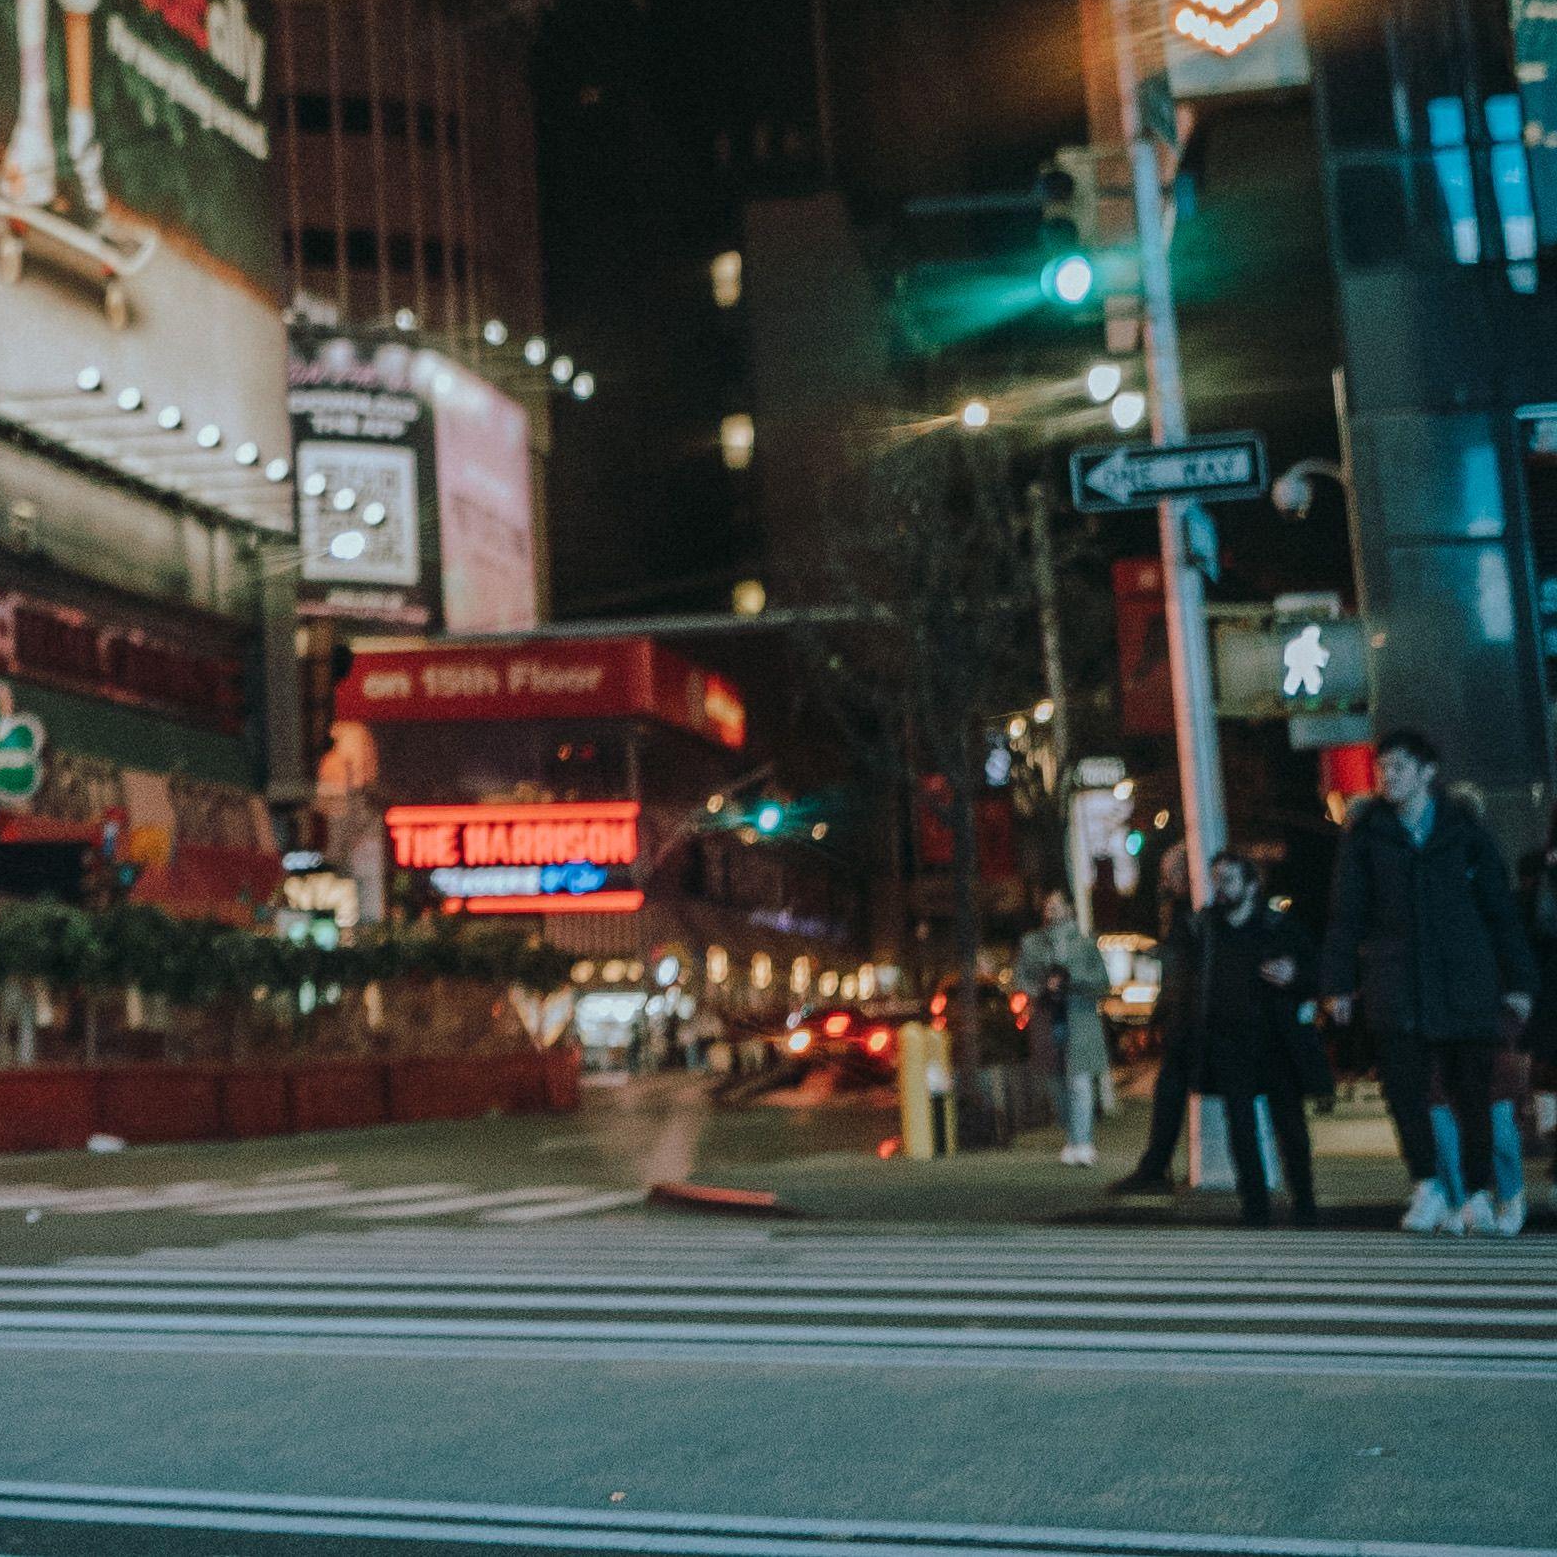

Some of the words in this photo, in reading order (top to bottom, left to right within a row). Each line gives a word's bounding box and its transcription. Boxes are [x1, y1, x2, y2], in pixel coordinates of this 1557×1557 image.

[362, 671, 411, 699] on
[507, 660, 603, 695] Floor
[393, 823, 461, 868] THE
[463, 819, 639, 866] HARRISON
